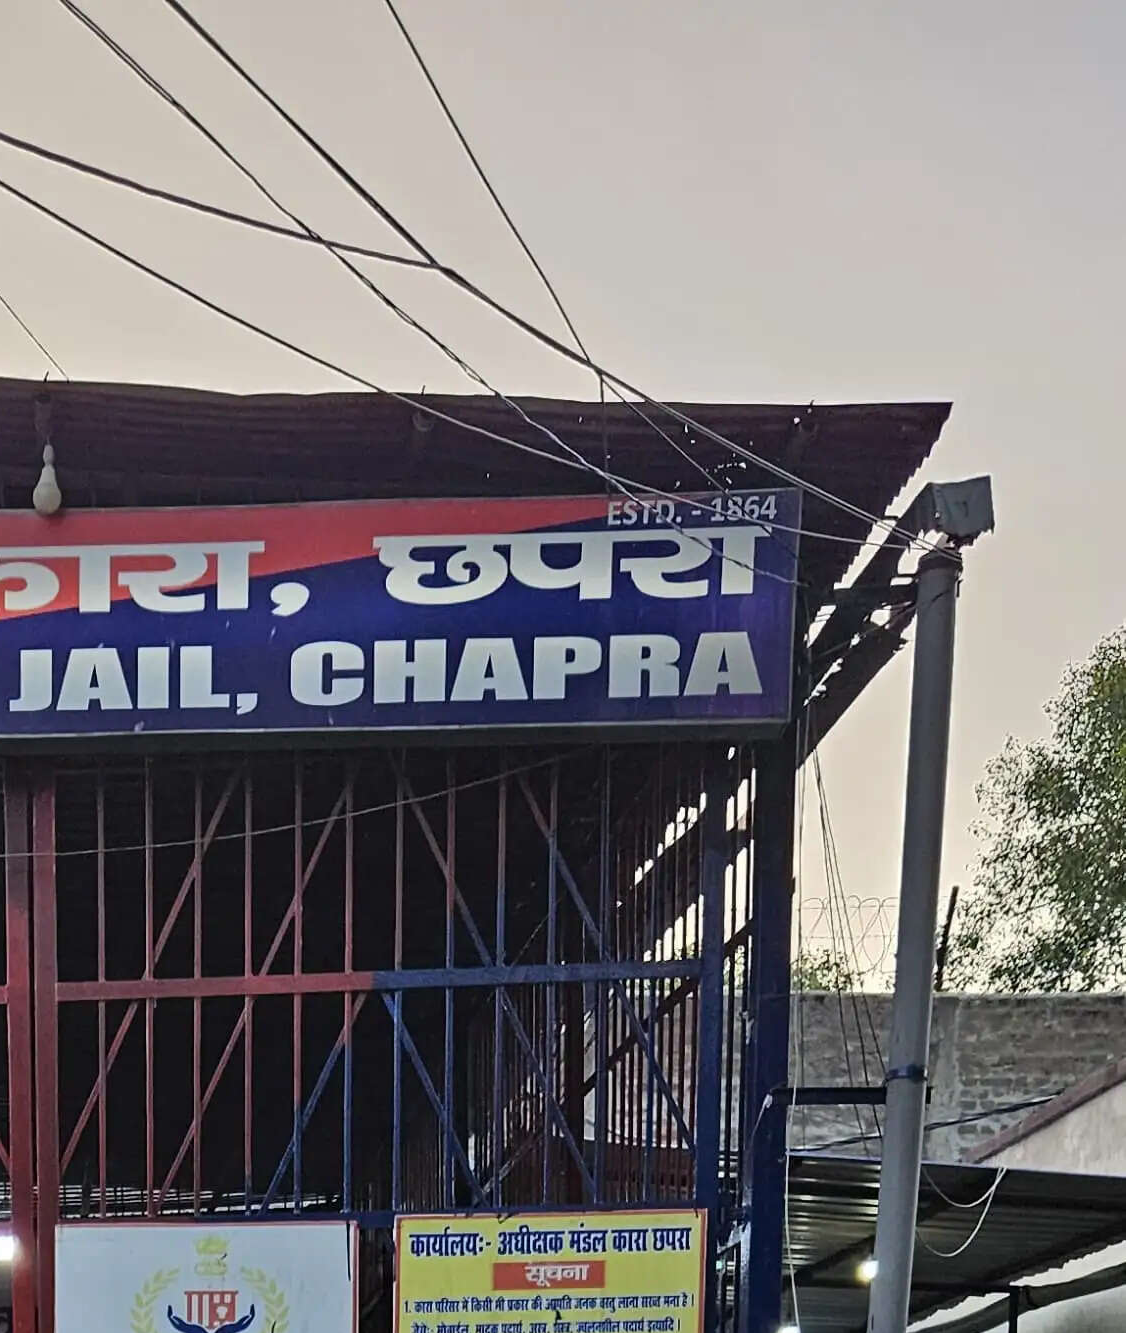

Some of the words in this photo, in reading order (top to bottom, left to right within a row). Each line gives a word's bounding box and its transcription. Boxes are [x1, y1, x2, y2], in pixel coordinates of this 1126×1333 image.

[607, 498, 684, 527] ESTD.
[709, 495, 778, 523] 1864
[372, 526, 773, 605] छपरा
[8, 645, 259, 716] JAIL,
[290, 631, 763, 707] CHAPRA
[497, 1225, 565, 1255] अधीक्षक
[568, 1222, 608, 1253] मंडल
[611, 1229, 649, 1252] कारा
[651, 1227, 692, 1251] छपरा
[524, 1263, 589, 1287] सूचना
[414, 1301, 434, 1312] कारा
[435, 1298, 459, 1312] परिसर
[471, 1297, 492, 1312] किसी
[507, 1299, 529, 1311] प्रकार
[531, 1296, 542, 1311] की
[617, 1296, 638, 1308] लाना
[663, 1295, 680, 1307] मना
